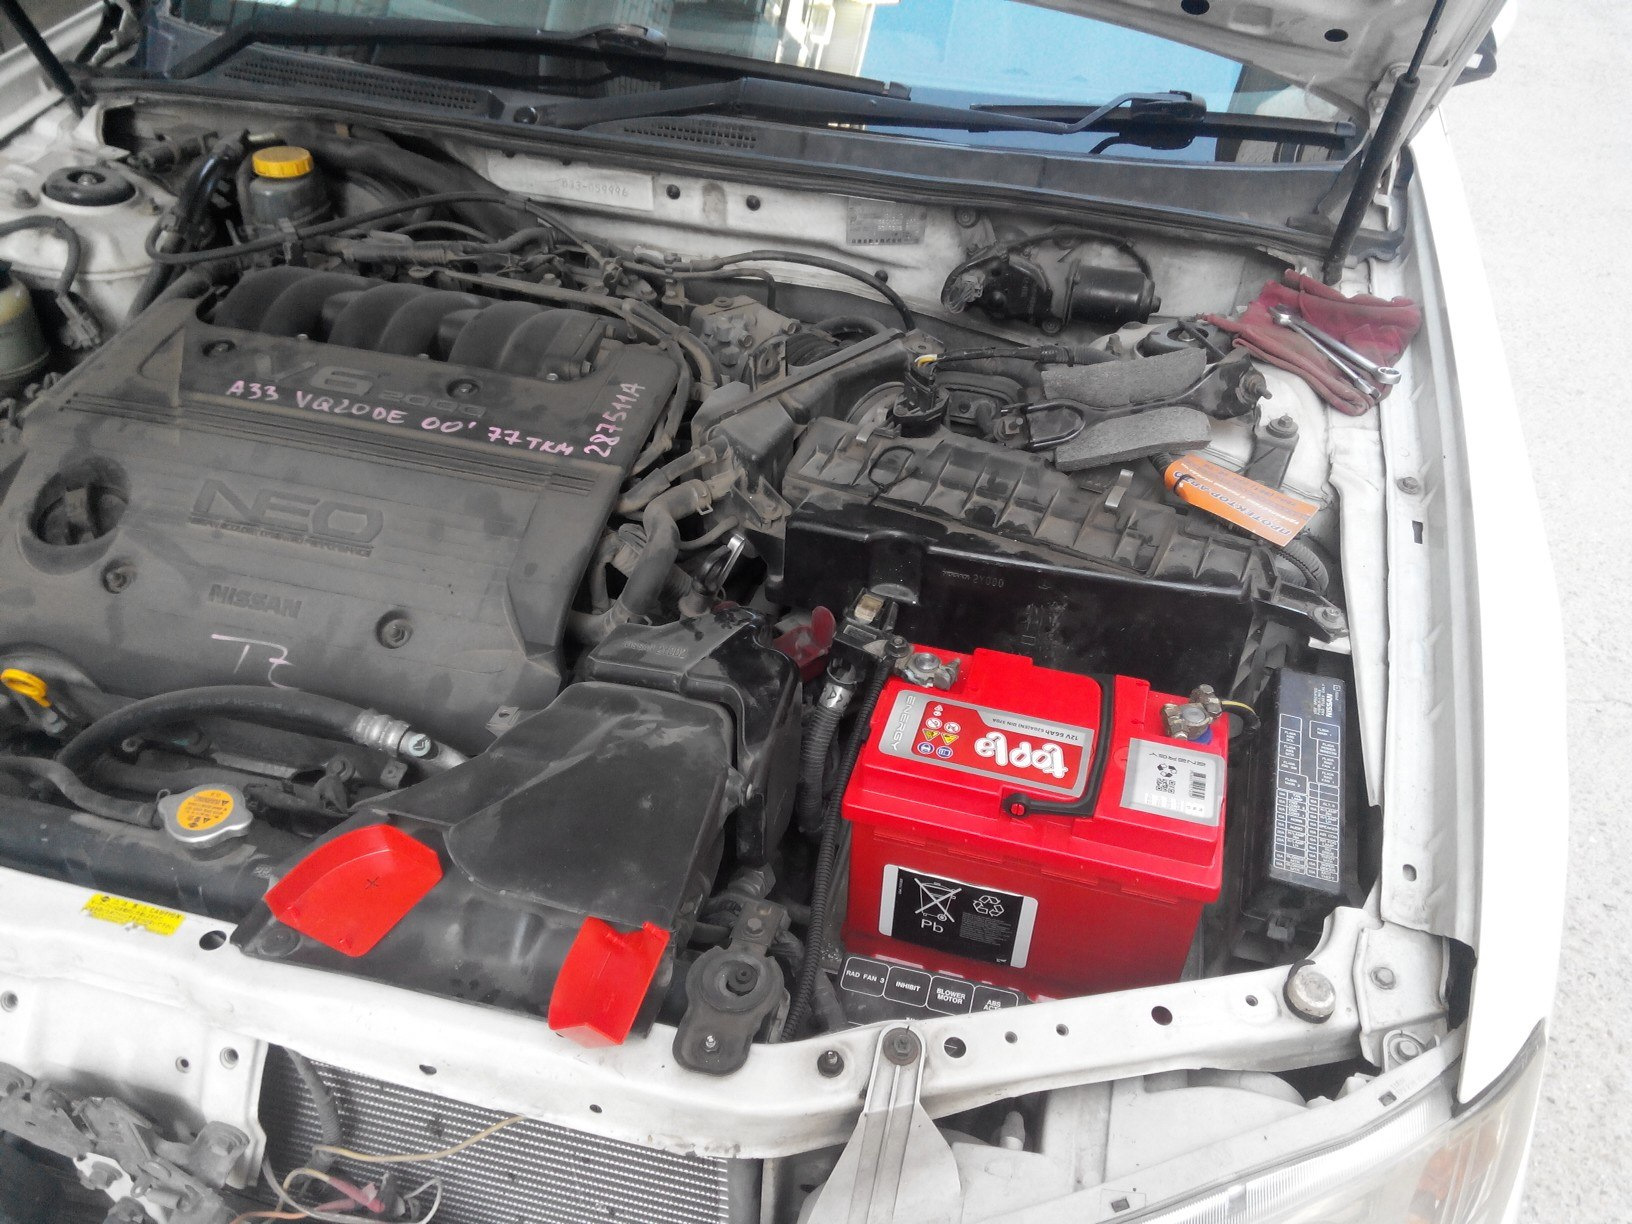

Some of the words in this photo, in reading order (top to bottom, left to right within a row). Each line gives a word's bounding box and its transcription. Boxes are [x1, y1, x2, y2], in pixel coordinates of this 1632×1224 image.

[226, 379, 280, 401] A33
[296, 390, 408, 424] VQ20DE
[192, 478, 385, 543] NEO
[208, 583, 302, 619] NISSAN
[891, 695, 916, 752] ENERGY
[1045, 729, 1065, 738] 66Ah
[973, 731, 1069, 779] topla
[1149, 752, 1207, 767] ENERGY
[920, 918, 944, 934] Pb
[846, 969, 860, 978] RAD
[862, 973, 878, 982] FAN
[895, 980, 921, 992] INHIBIT
[936, 987, 966, 1000] BLOWER
[937, 993, 963, 1005] MOTOR
[986, 999, 1001, 1008] ABS
